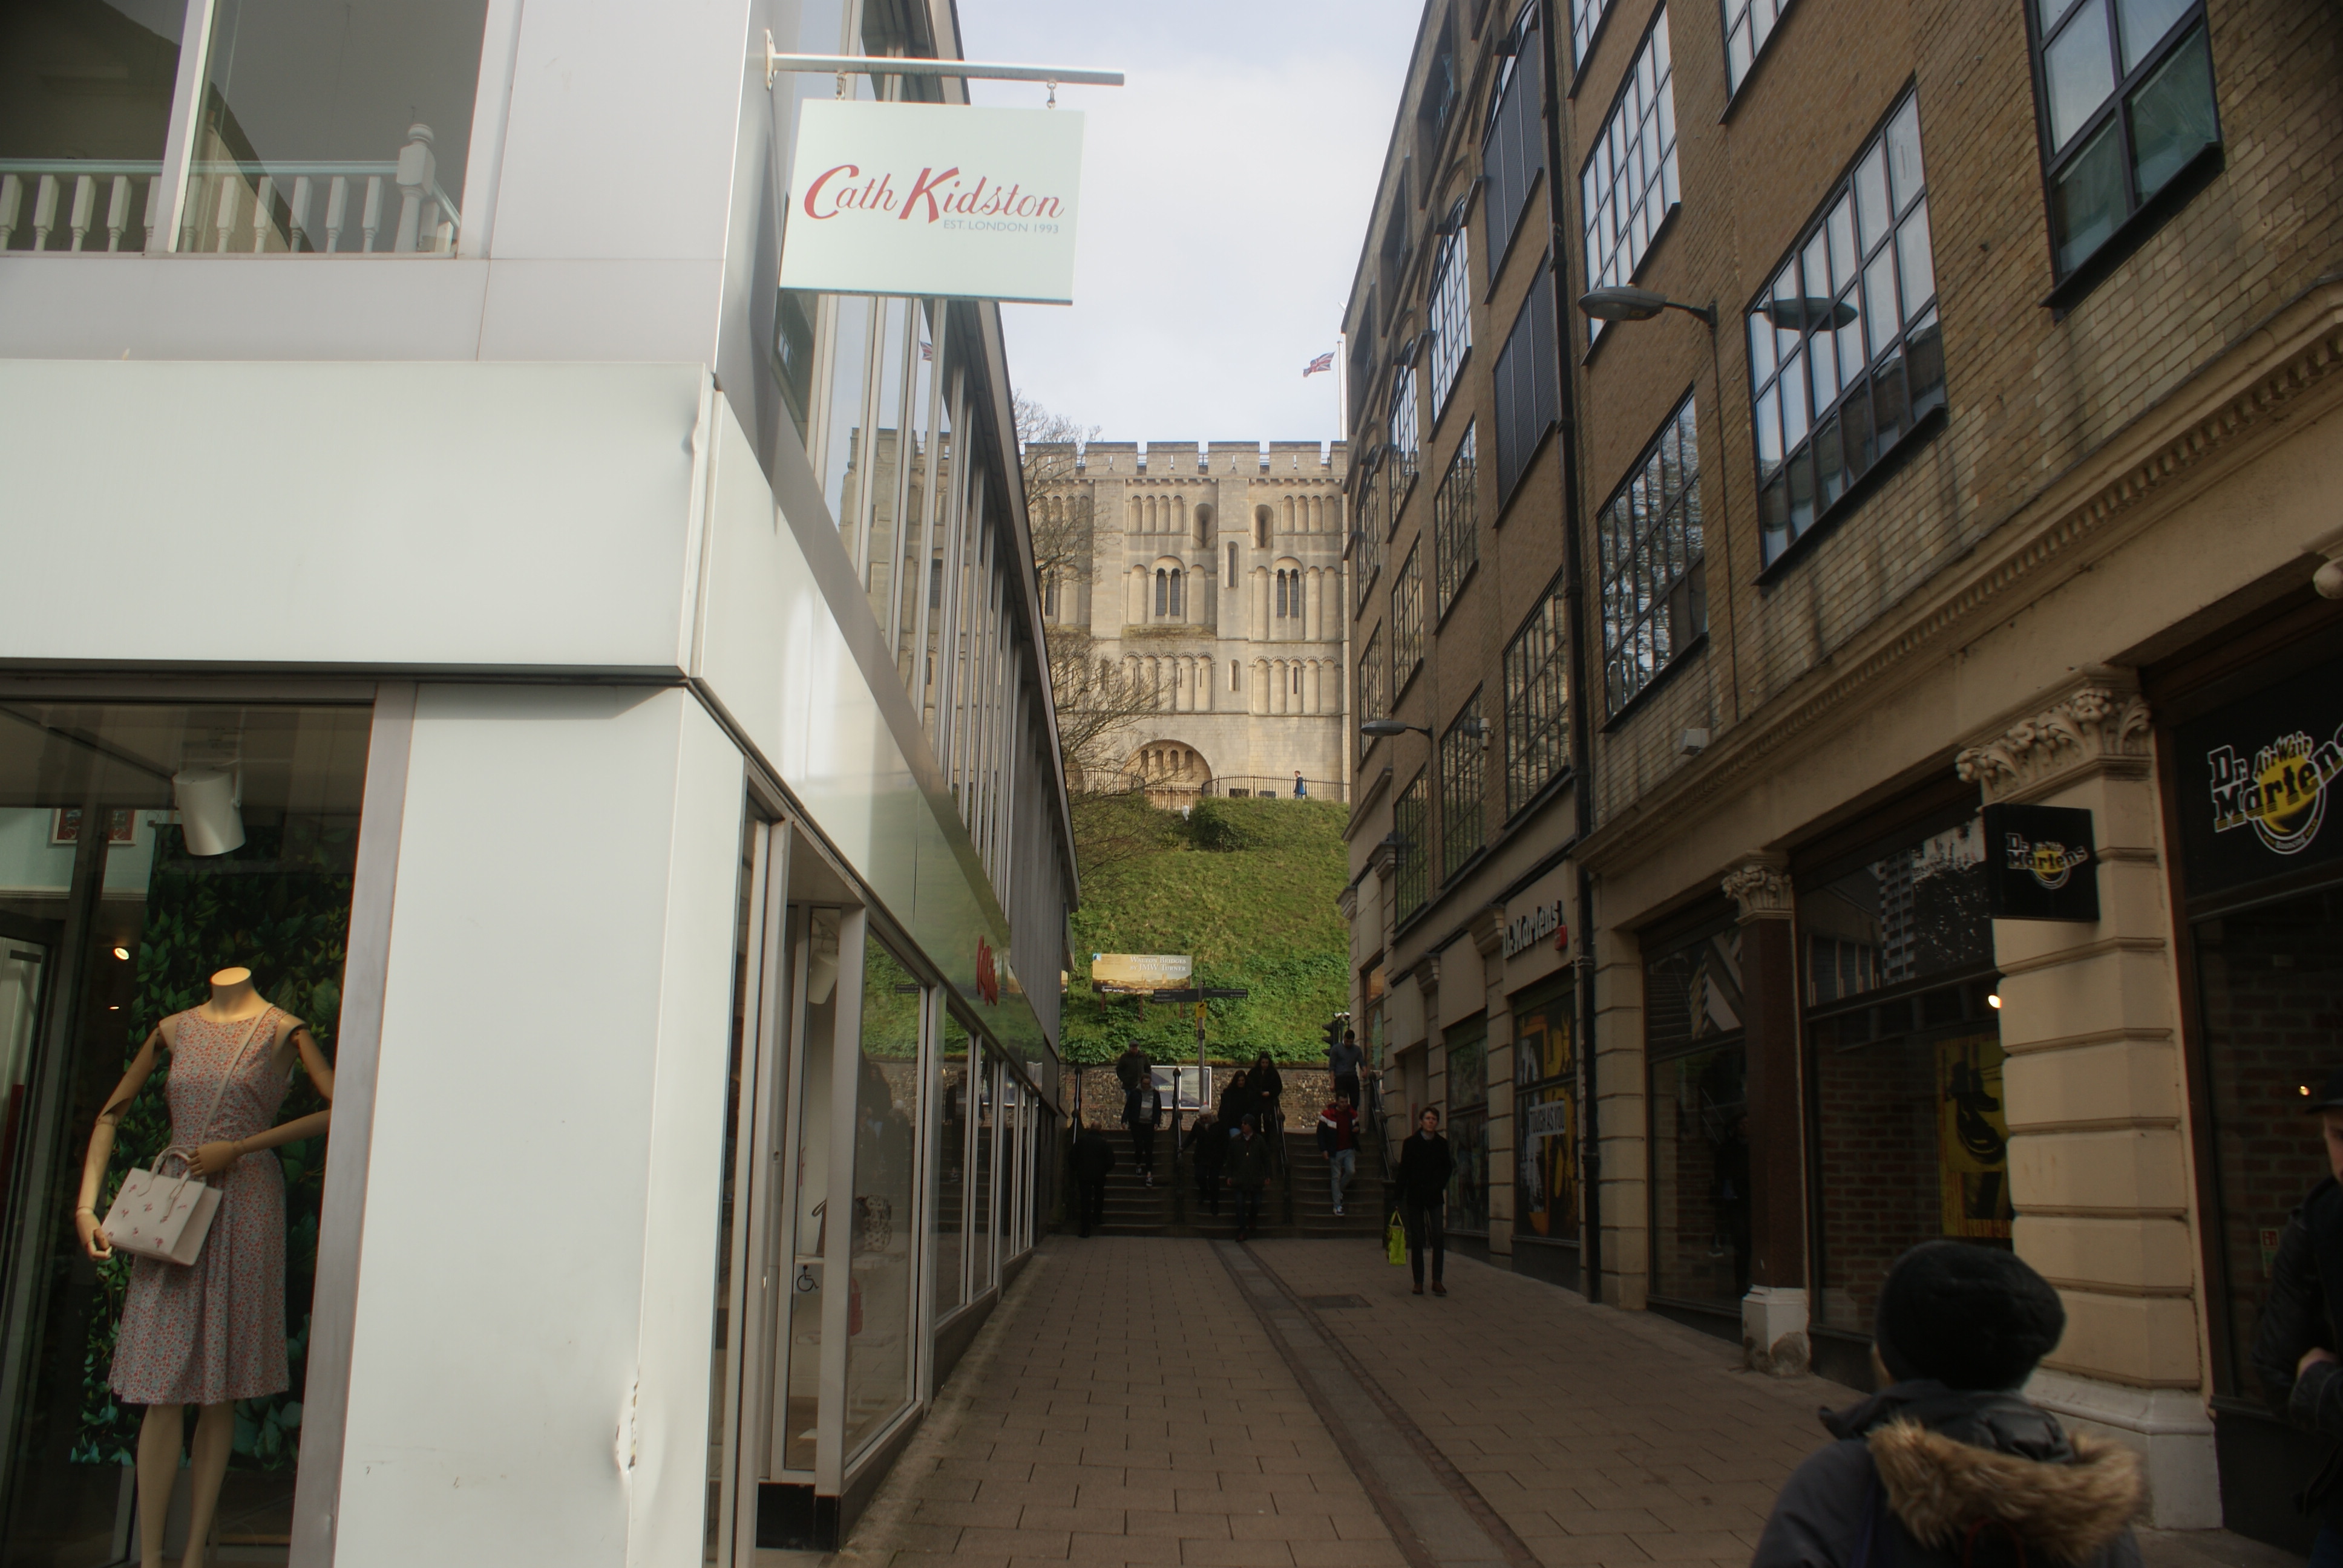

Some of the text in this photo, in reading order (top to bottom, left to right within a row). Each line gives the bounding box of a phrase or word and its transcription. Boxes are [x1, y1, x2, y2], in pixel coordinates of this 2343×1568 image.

[804, 164, 1065, 224] Cath Kidston
[943, 219, 1060, 235] EST. LONDON 1993
[2007, 845, 2089, 872] Martens
[1138, 964, 1158, 972] JMW
